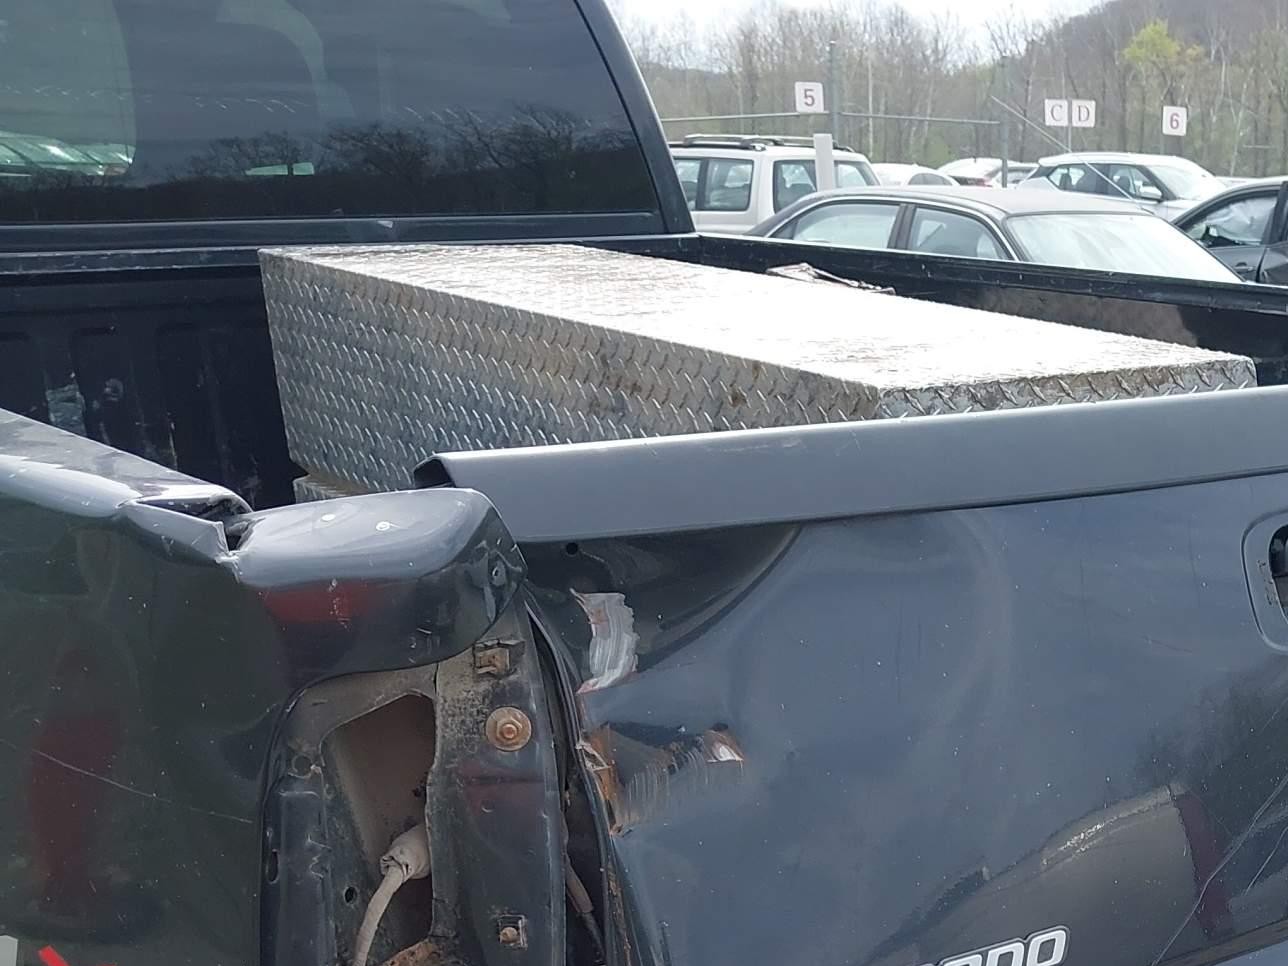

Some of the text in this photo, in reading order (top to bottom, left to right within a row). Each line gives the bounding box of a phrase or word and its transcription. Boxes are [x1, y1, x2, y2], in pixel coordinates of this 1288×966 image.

[803, 88, 815, 107] 5
[1050, 103, 1063, 122] C
[1077, 104, 1090, 122] D
[1170, 112, 1180, 130] 6
